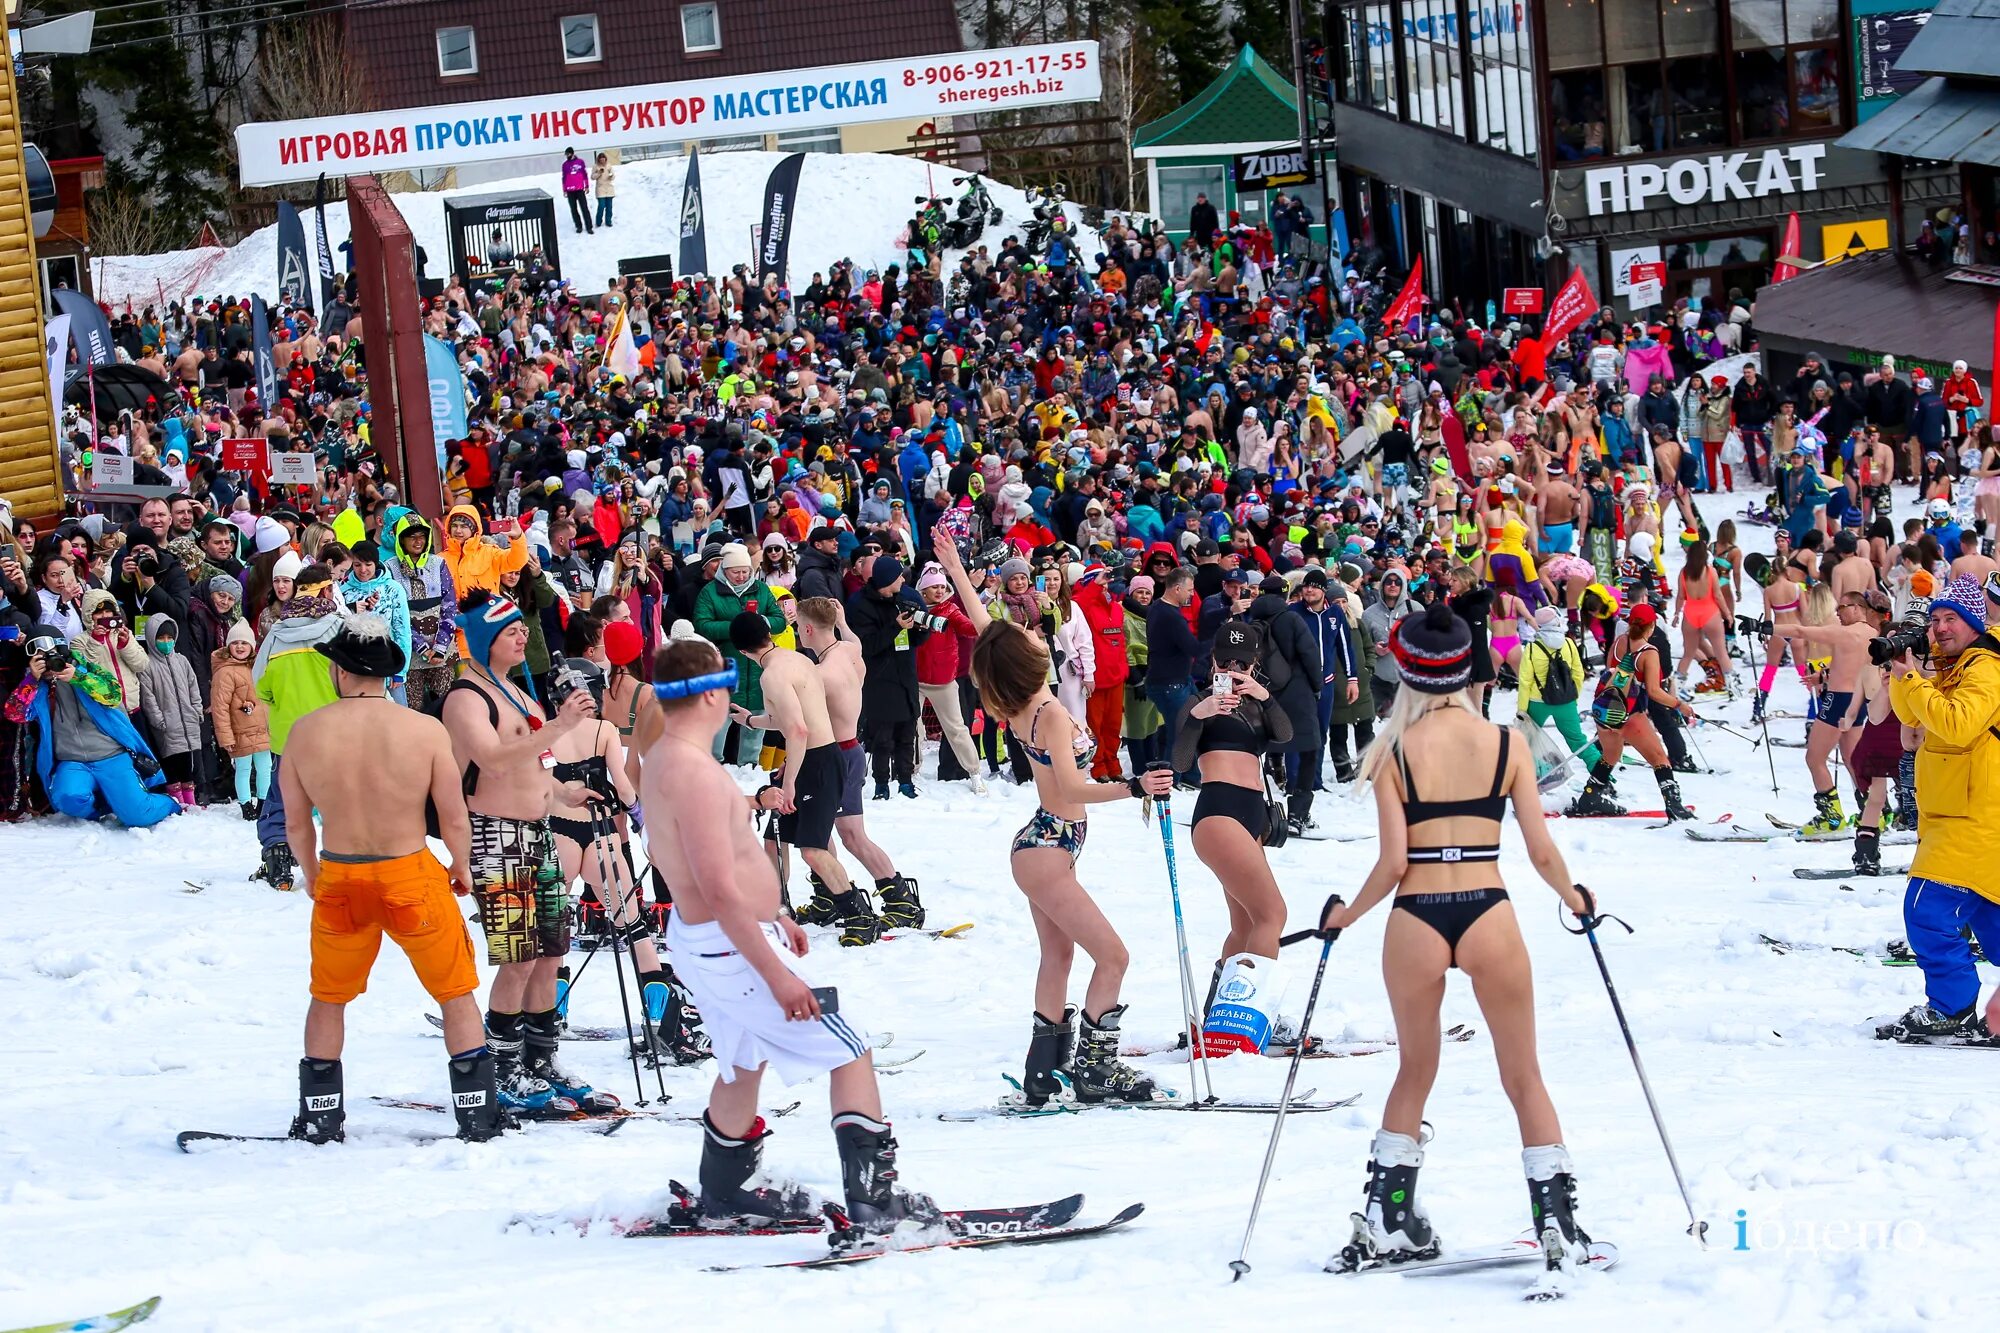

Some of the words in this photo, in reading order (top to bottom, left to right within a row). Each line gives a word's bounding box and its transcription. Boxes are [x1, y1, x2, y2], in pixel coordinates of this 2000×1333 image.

[903, 51, 1088, 87] 8-906-921-17-55
[938, 77, 1063, 105] sheregesh.biz
[279, 126, 407, 166] ИГРОВАЯ
[415, 115, 523, 151] ПРОКАТ
[531, 96, 706, 139] ИНСТРУКТОР
[714, 78, 888, 121] МАСТЕРСКАЯ
[1242, 153, 1308, 181] ZUBR
[1585, 143, 1826, 216] ПРОКАТ
[764, 192, 784, 265] Adrenaline
[1868, 355, 1905, 370] SPT
[1908, 360, 1954, 378] SERVIC
[1445, 850, 1458, 860] CK
[1209, 1009, 1254, 1022] АВЕЛЬЕВ
[1222, 1020, 1258, 1035] Иванович
